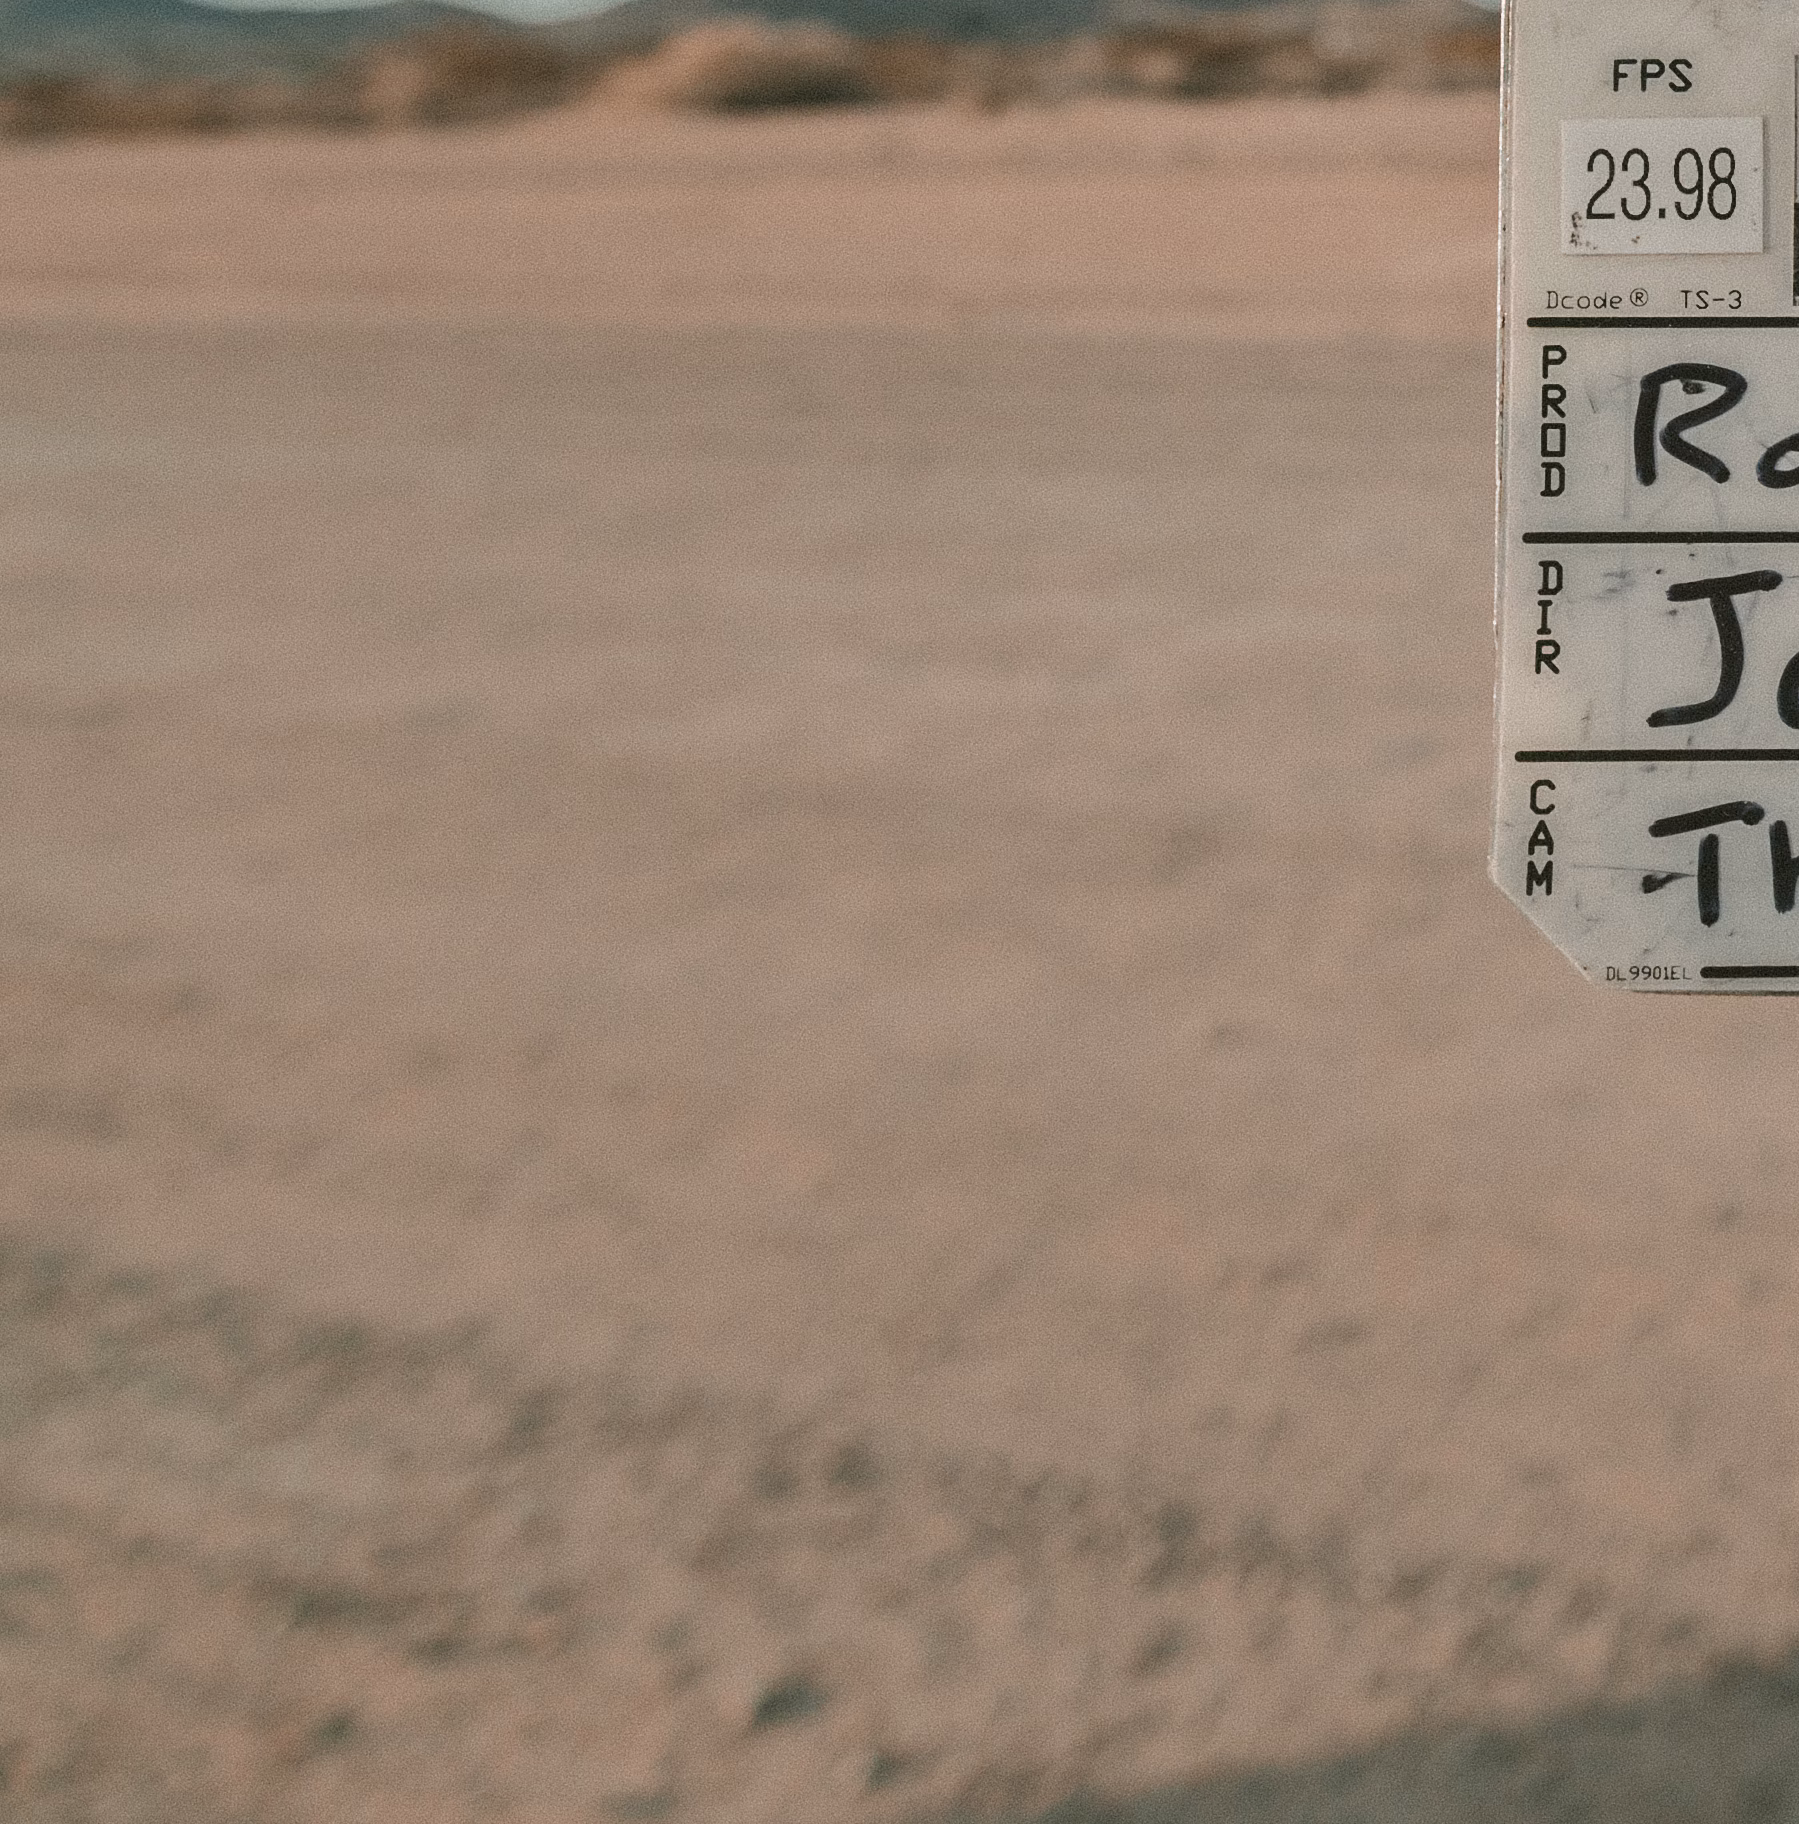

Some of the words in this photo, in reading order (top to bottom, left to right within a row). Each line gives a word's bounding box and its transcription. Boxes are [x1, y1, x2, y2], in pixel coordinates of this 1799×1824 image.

[1611, 58, 1694, 93] FPS
[1585, 146, 1738, 221] 23.98
[1680, 289, 1743, 310] TS-3
[1540, 344, 1567, 499] PROD
[1534, 560, 1565, 677] DIR
[1525, 778, 1556, 898] CAM
